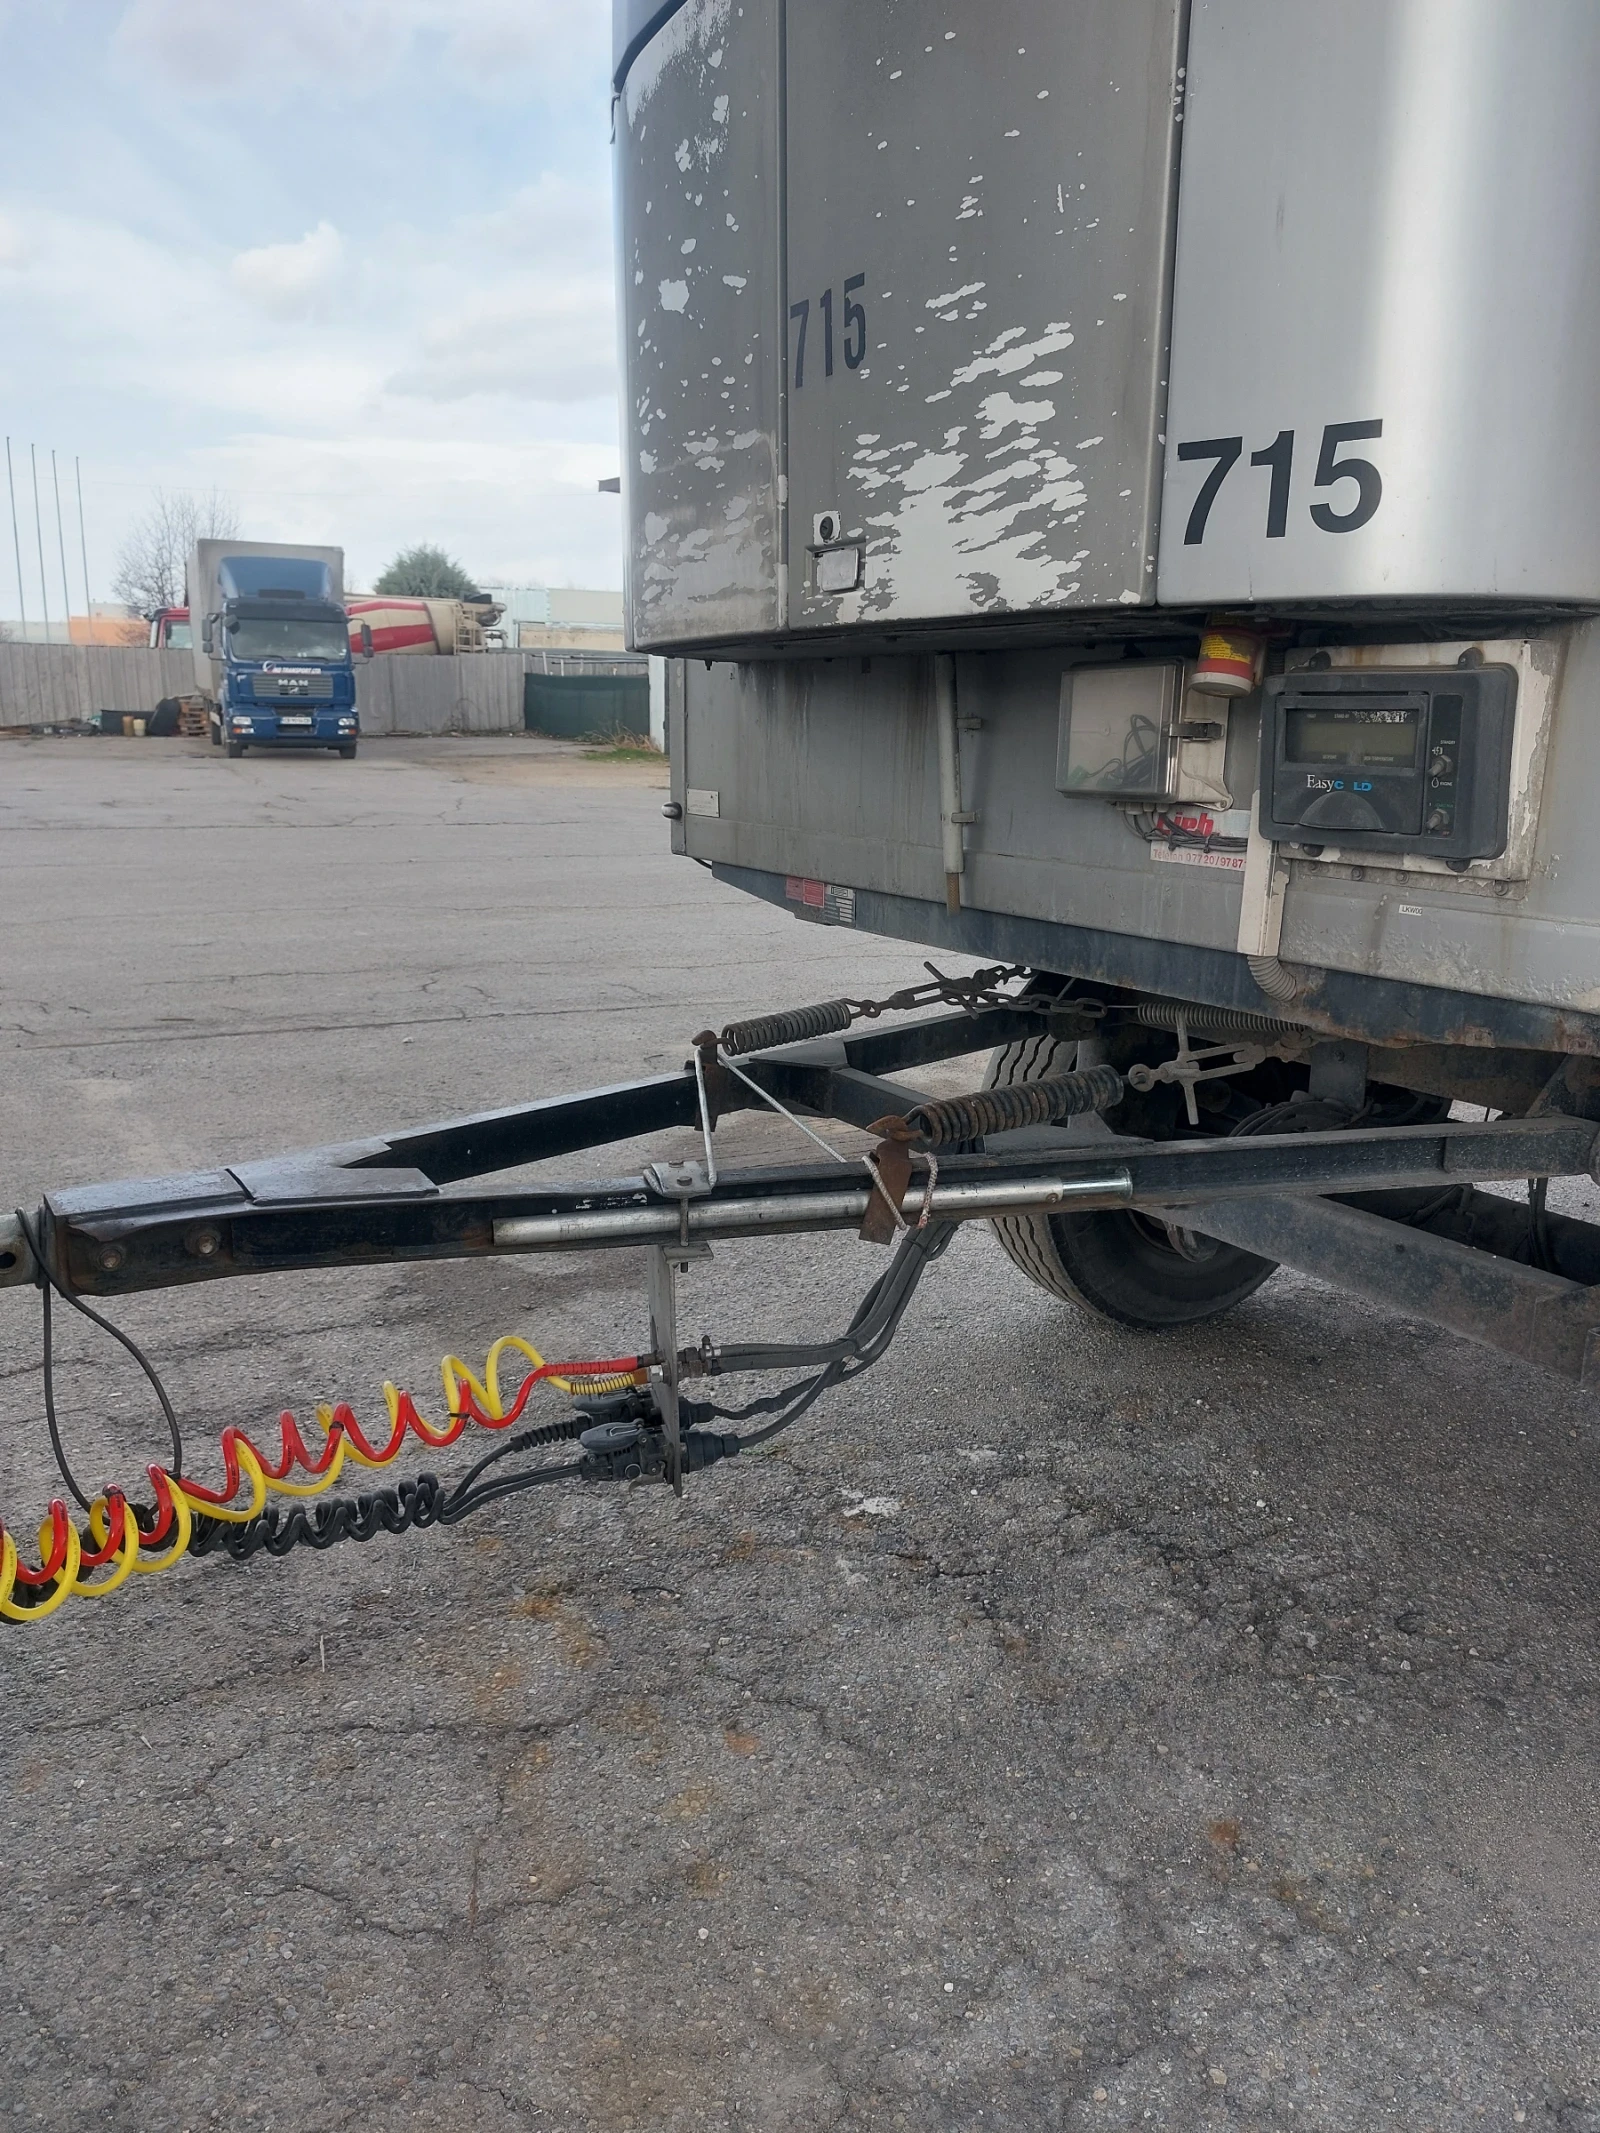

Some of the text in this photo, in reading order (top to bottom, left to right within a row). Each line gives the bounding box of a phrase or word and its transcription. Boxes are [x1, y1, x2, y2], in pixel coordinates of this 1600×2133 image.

[789, 272, 866, 388] 715
[1177, 418, 1384, 545] 715
[277, 679, 309, 687] MAN
[1153, 848, 1247, 869] Telefon 07720/9787
